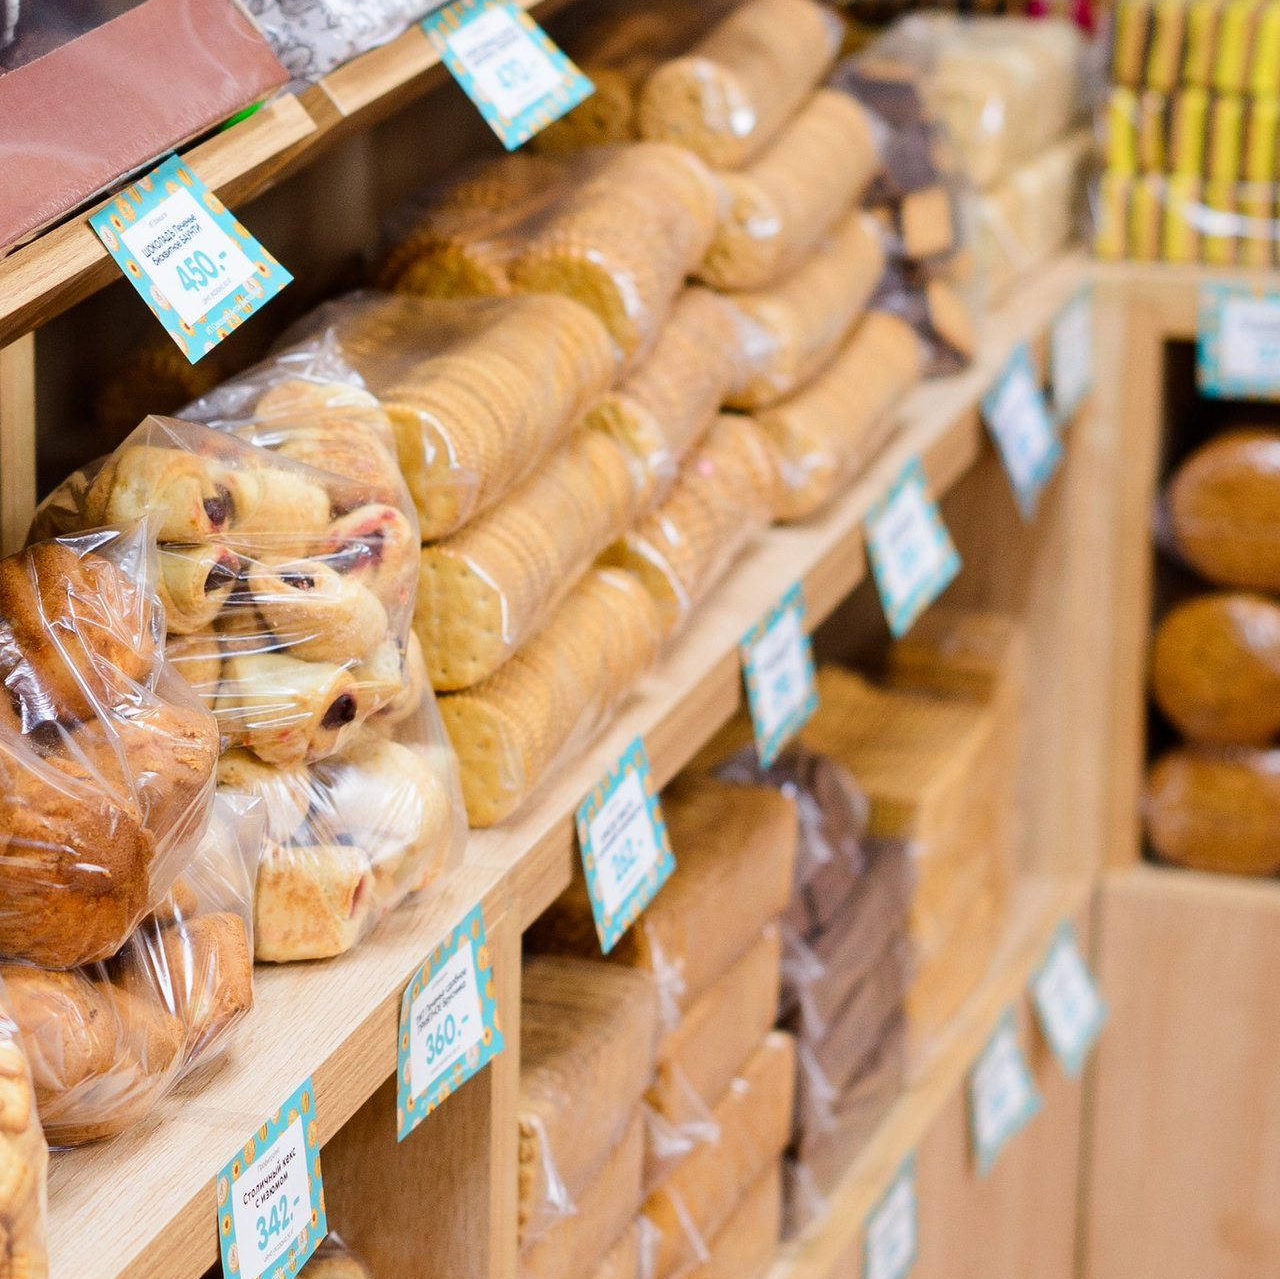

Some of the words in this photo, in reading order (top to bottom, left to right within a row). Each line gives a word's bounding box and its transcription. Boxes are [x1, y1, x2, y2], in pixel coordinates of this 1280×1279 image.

[141, 228, 176, 258] ШОКОЛАДЪ
[176, 250, 227, 292] 450.-
[426, 1014, 469, 1065] 360.-
[243, 1159, 283, 1207] Столичный
[282, 1145, 297, 1168] кекс
[261, 1171, 289, 1204] изюмом
[256, 1194, 300, 1251] 342.-
